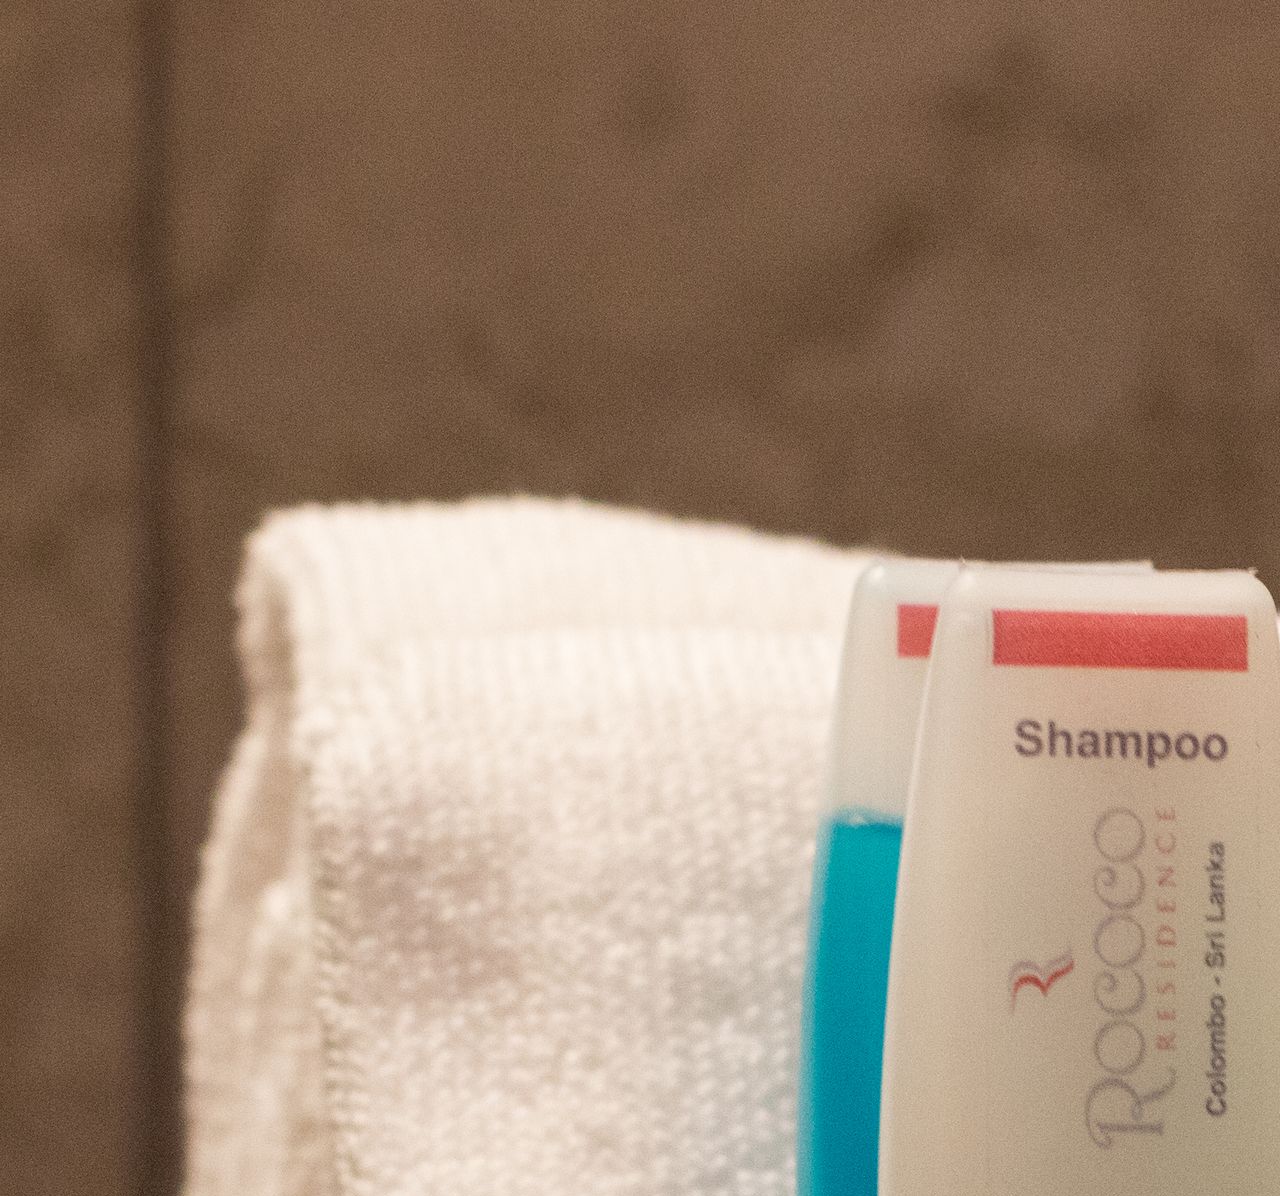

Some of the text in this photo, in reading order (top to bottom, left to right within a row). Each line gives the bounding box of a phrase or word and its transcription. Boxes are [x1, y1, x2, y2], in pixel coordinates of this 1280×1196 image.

[1014, 718, 1230, 770] Shampoo
[1203, 841, 1227, 924] Lanka
[1153, 805, 1178, 1053] RESIDENCE
[1203, 930, 1227, 969] Sri
[1204, 993, 1228, 1119] Colombo
